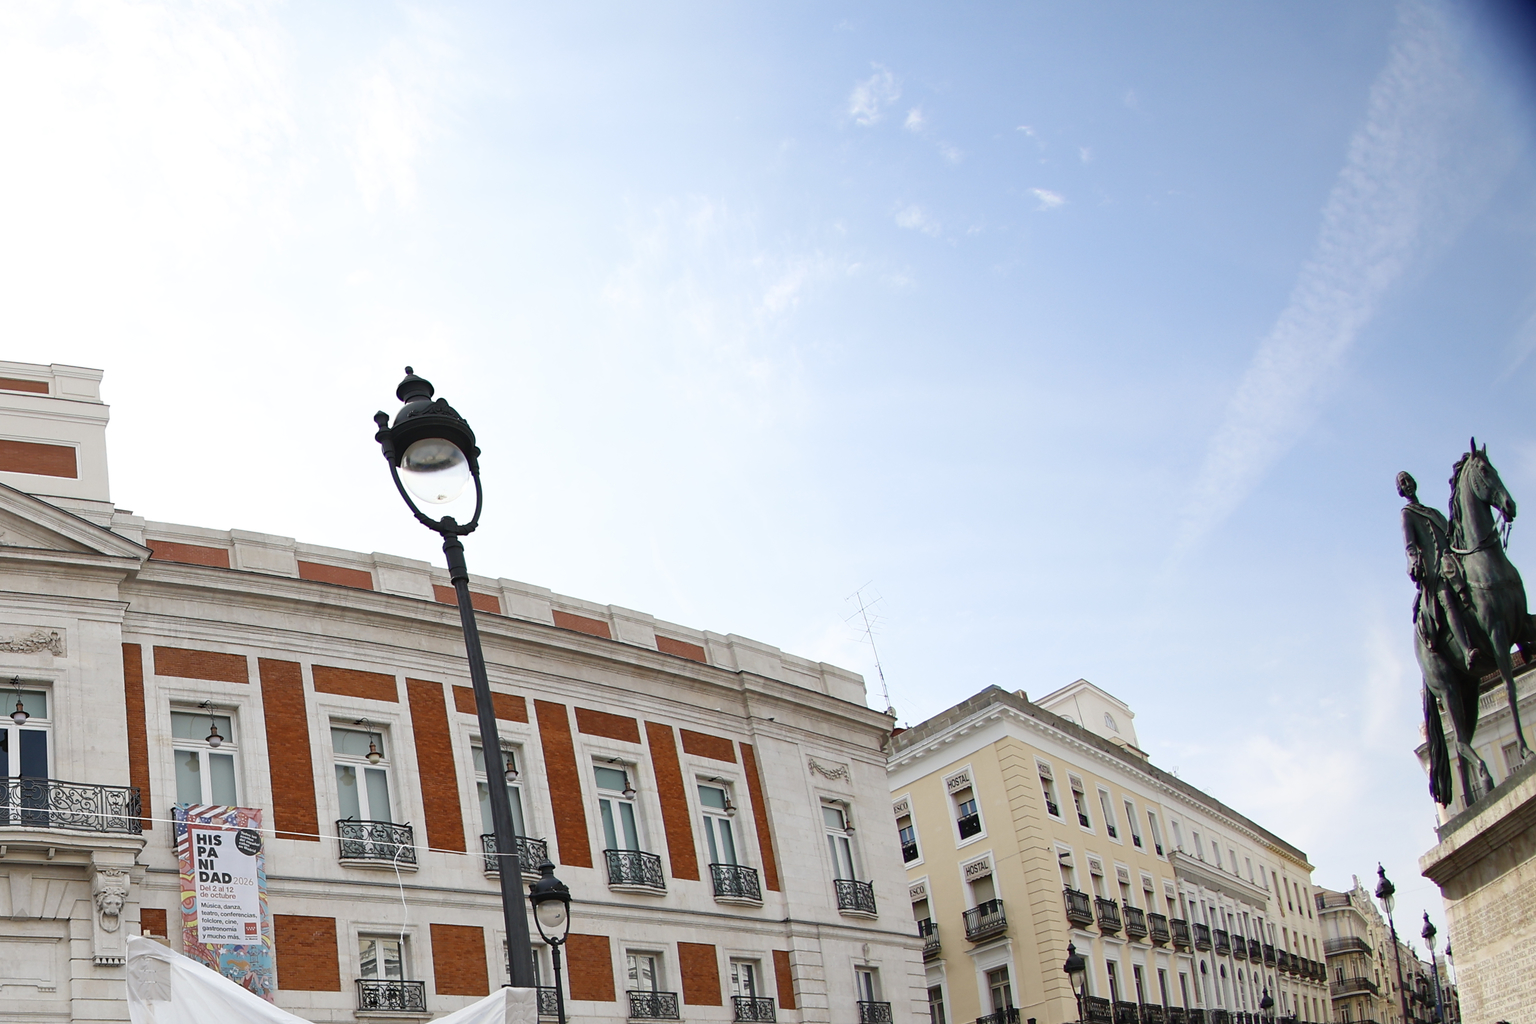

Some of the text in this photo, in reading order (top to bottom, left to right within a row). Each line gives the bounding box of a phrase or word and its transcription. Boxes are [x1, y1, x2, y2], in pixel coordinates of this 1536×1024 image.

[947, 774, 970, 789] HOSTAL
[196, 833, 222, 846] HIS
[197, 845, 218, 858] PA
[198, 858, 214, 871] NI
[965, 860, 989, 877] HOSTAL
[199, 871, 254, 886] DAD 2026
